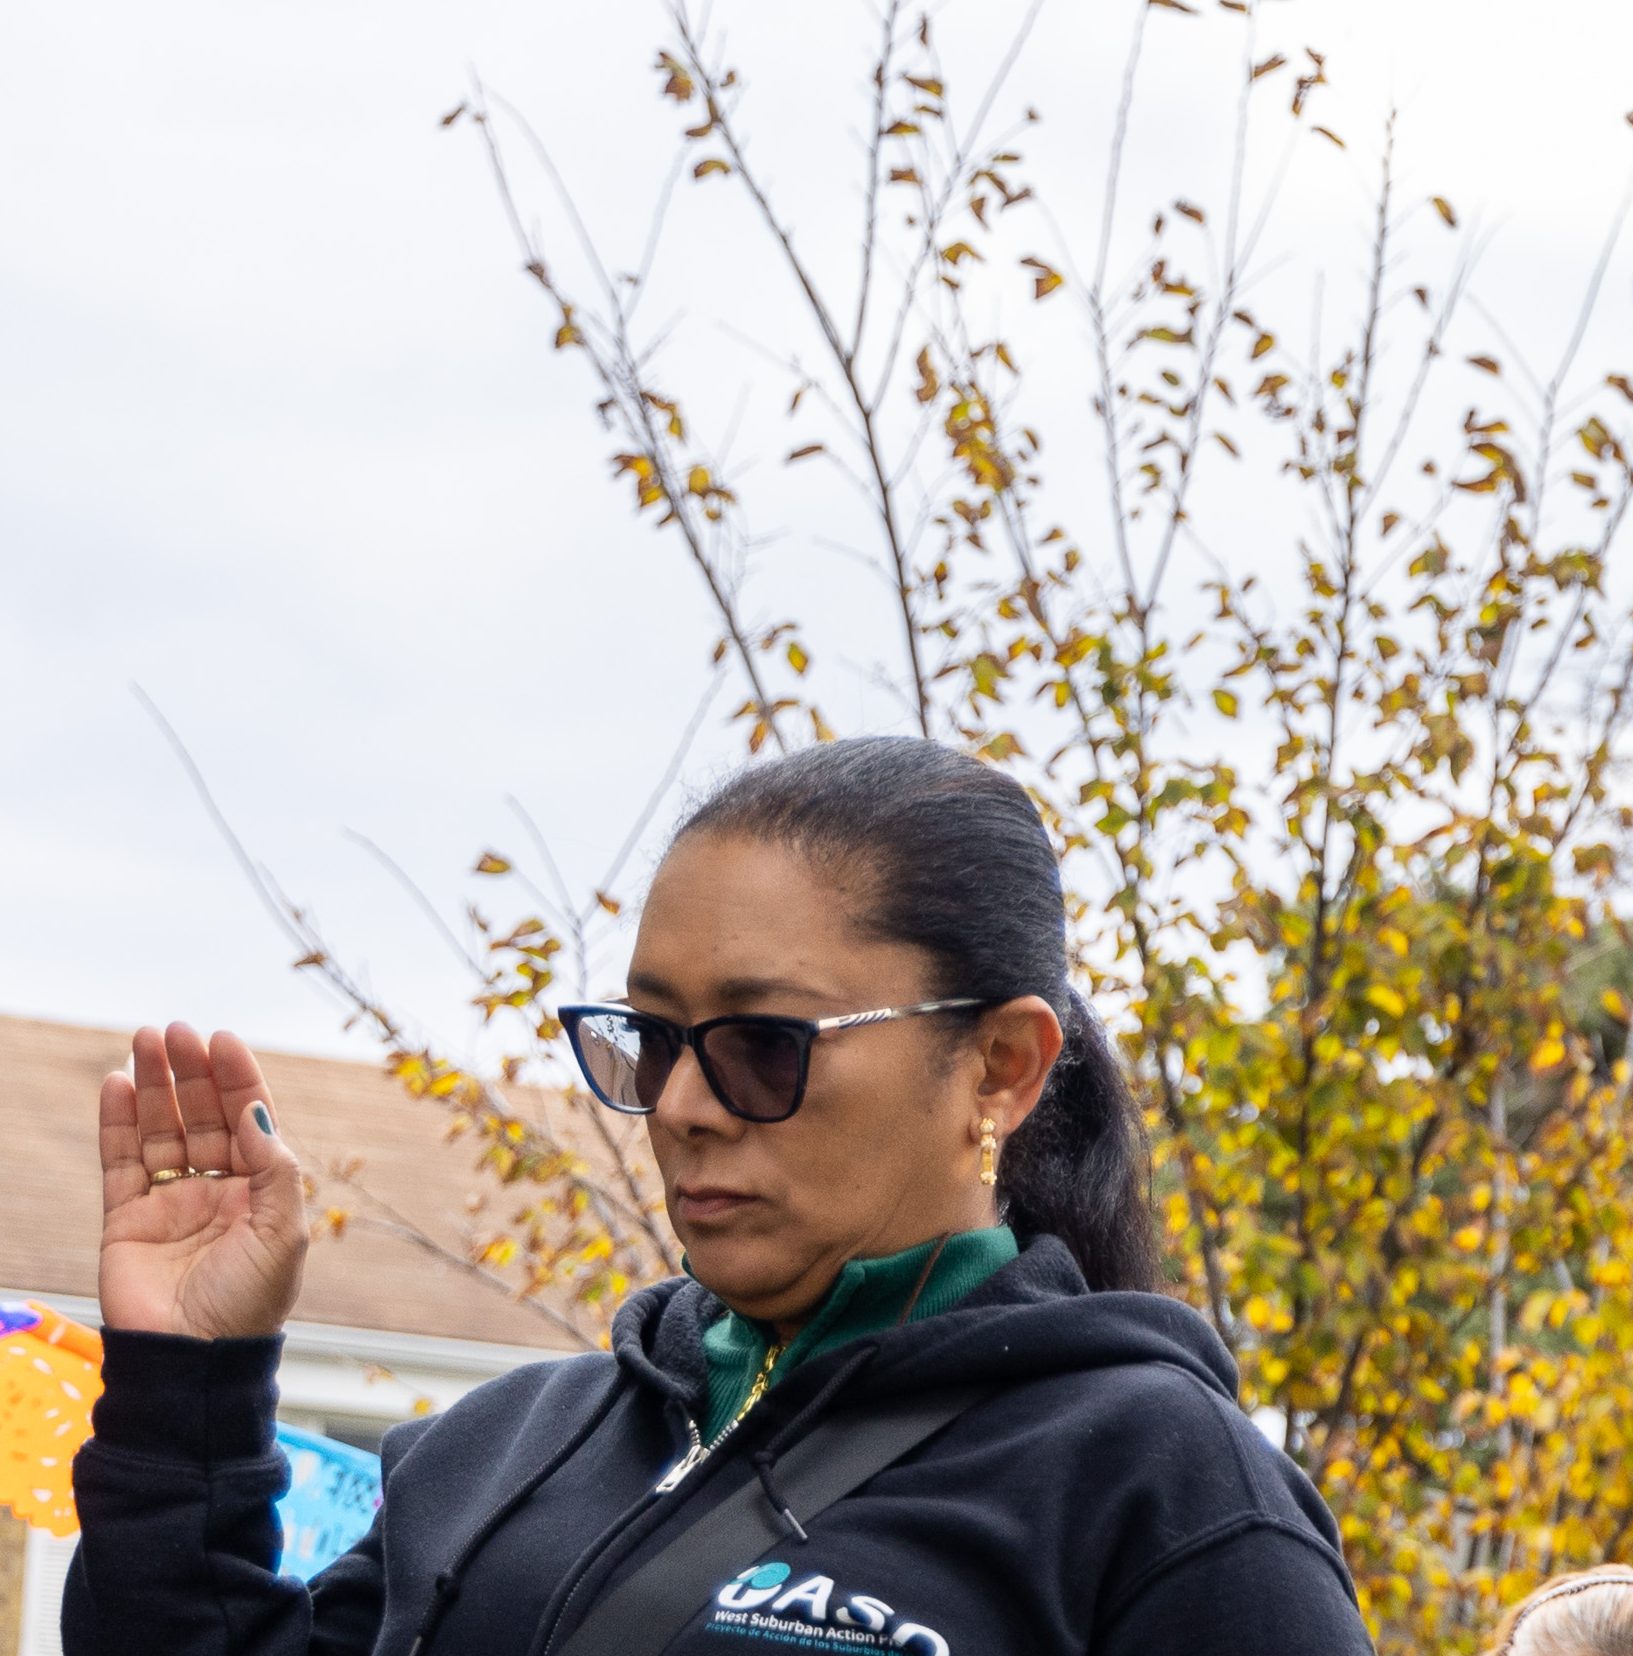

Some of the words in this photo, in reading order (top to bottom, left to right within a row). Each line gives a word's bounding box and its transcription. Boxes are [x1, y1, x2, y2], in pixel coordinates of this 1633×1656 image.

[714, 1610, 749, 1625] West
[750, 1613, 823, 1638] Suburban
[825, 1627, 876, 1644] Action
